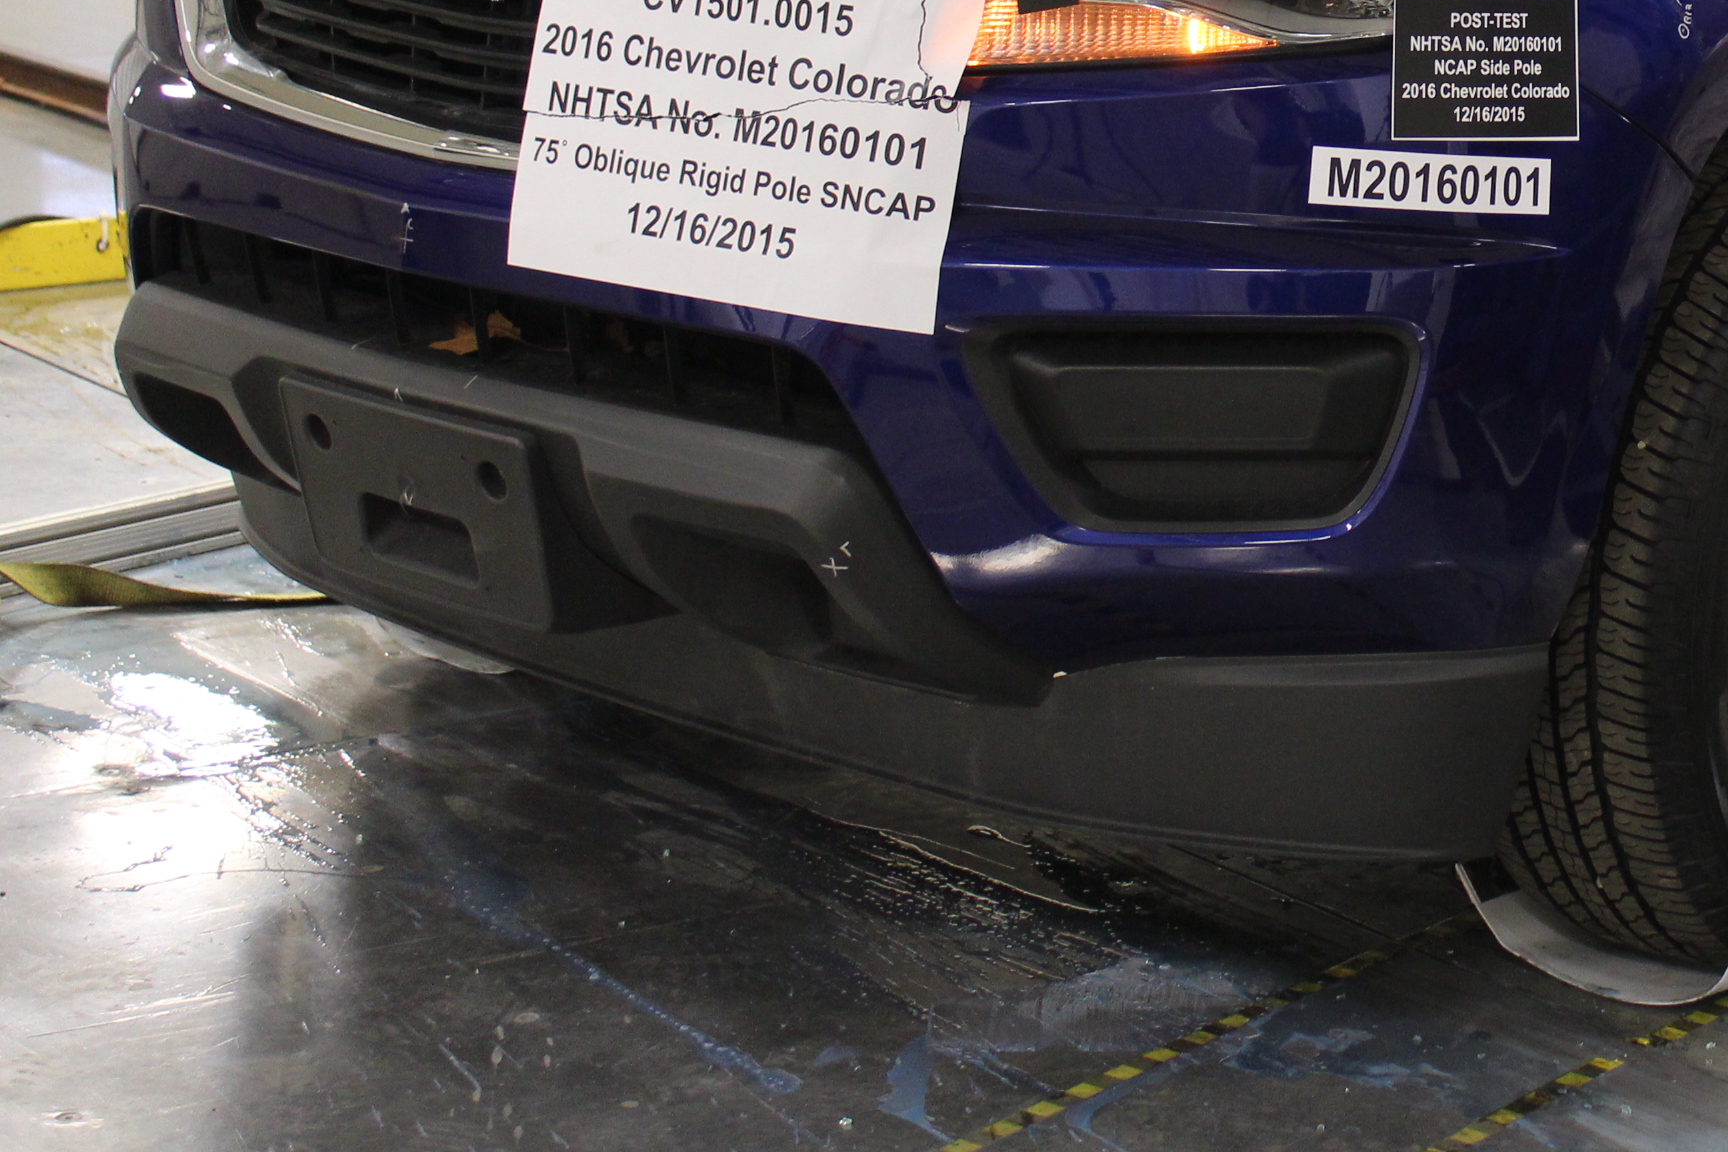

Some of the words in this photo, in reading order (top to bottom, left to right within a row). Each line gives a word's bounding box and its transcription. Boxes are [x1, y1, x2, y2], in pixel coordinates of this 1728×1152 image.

[1450, 11, 1529, 30] POST-TEST
[1410, 35, 1462, 52] NHTSA
[1466, 36, 1489, 53] No.
[1493, 36, 1562, 53] M20160101
[541, 22, 613, 62] 2016
[623, 34, 779, 88] Chevrolet
[788, 57, 959, 115] Colorado
[1434, 59, 1477, 76] NCAP
[1480, 59, 1511, 76] Side
[1514, 59, 1542, 76] Pole
[1402, 83, 1436, 99] 2016
[1440, 82, 1508, 100] Chevrolet
[1511, 82, 1570, 99] Colorado
[548, 80, 659, 131] NHTSA
[669, 97, 721, 140] No.
[733, 108, 928, 170] M20160101
[1453, 105, 1526, 123] 12/16/2015
[574, 143, 671, 183] Oblique
[679, 158, 744, 198] Rigid
[753, 170, 811, 204] Pole
[820, 181, 936, 223] SNCAP
[1327, 156, 1541, 208] M20160101
[626, 202, 797, 260] 12/16/2015
